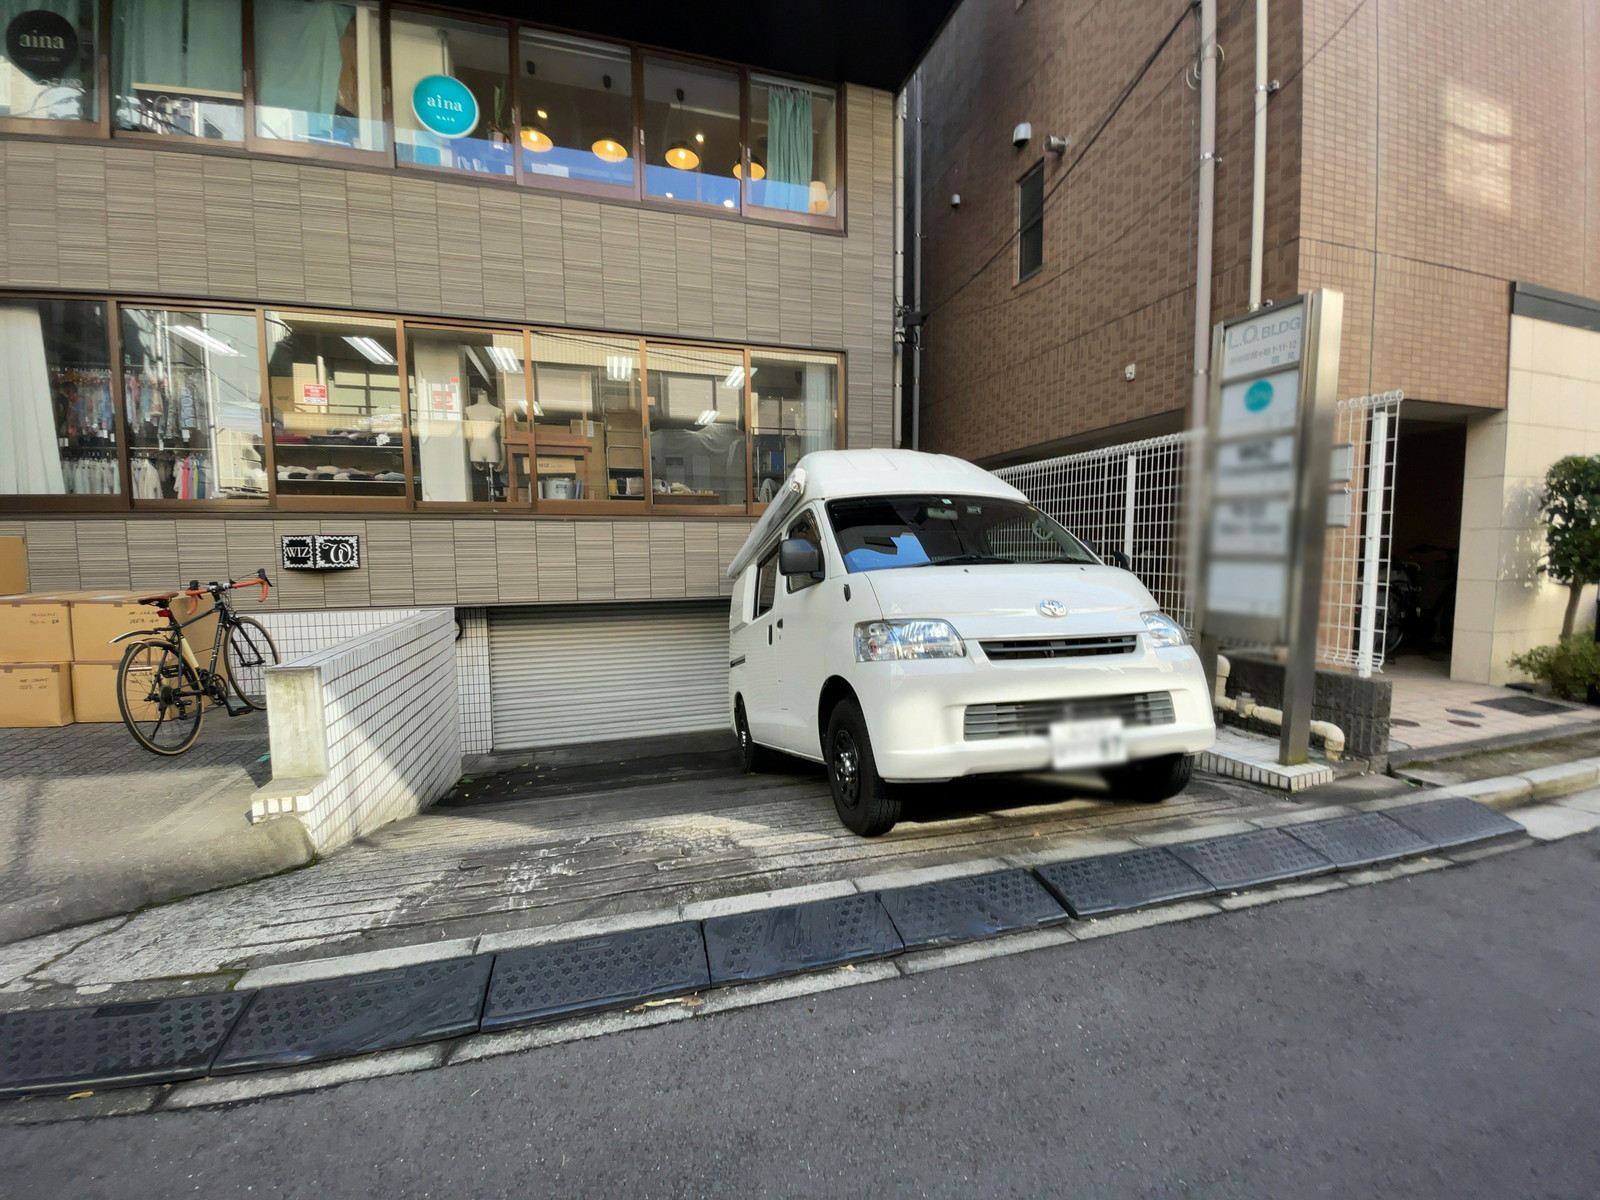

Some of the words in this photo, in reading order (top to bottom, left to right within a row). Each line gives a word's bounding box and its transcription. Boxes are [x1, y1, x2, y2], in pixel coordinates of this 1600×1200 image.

[19, 29, 65, 50] aina
[426, 94, 463, 112] aina
[286, 546, 310, 558] WIZ
